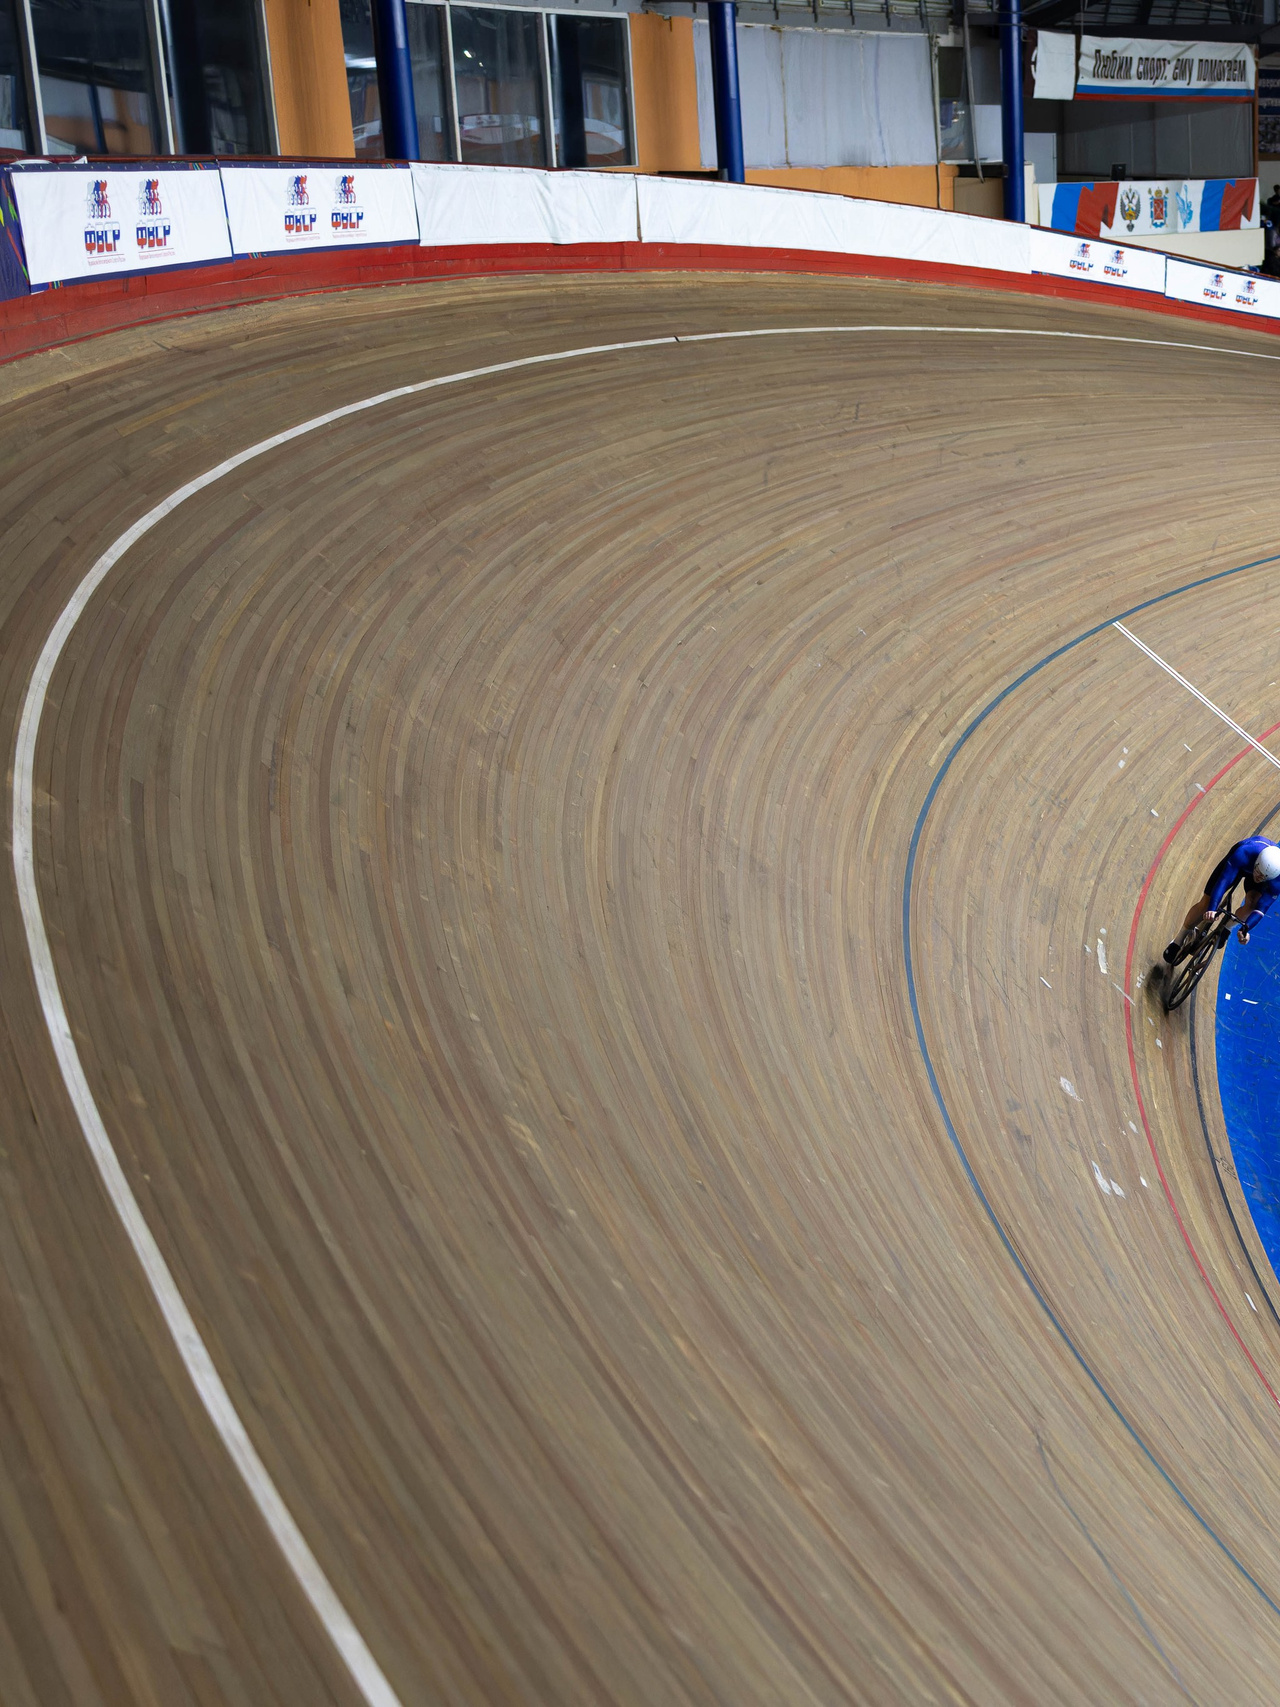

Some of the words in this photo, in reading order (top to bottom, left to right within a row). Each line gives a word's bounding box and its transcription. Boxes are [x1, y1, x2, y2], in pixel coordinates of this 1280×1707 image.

[1092, 49, 1133, 80] Любим
[1172, 58, 1194, 86] ему
[1197, 58, 1247, 82] помогаем
